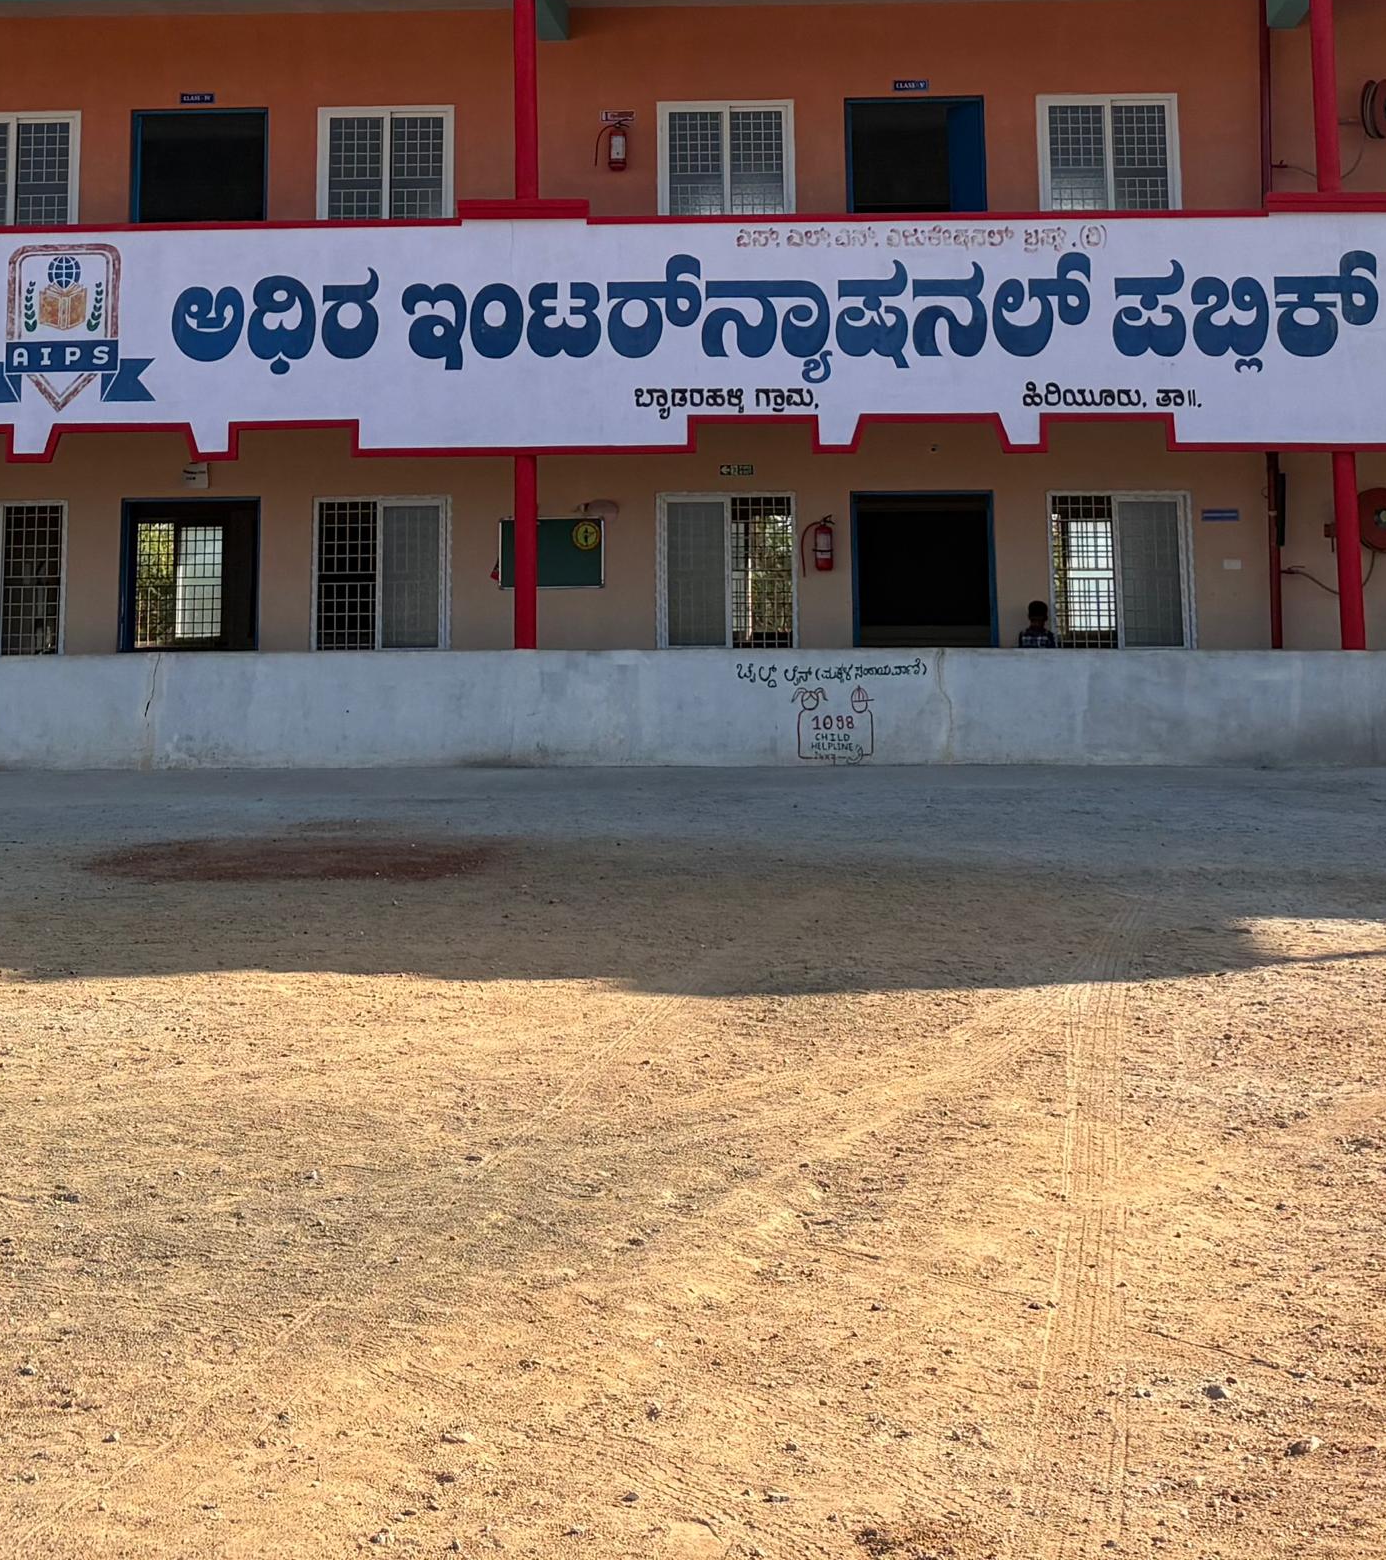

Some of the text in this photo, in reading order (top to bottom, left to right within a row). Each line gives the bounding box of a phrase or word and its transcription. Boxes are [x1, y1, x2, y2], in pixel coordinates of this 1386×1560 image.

[171, 266, 380, 375] ಅಧಿರ
[1112, 249, 1379, 374] ಪಬ್ಲಿಕ್
[811, 715, 855, 730] 1098
[815, 733, 850, 741] CHILD
[811, 742, 854, 751] HELPLINE
